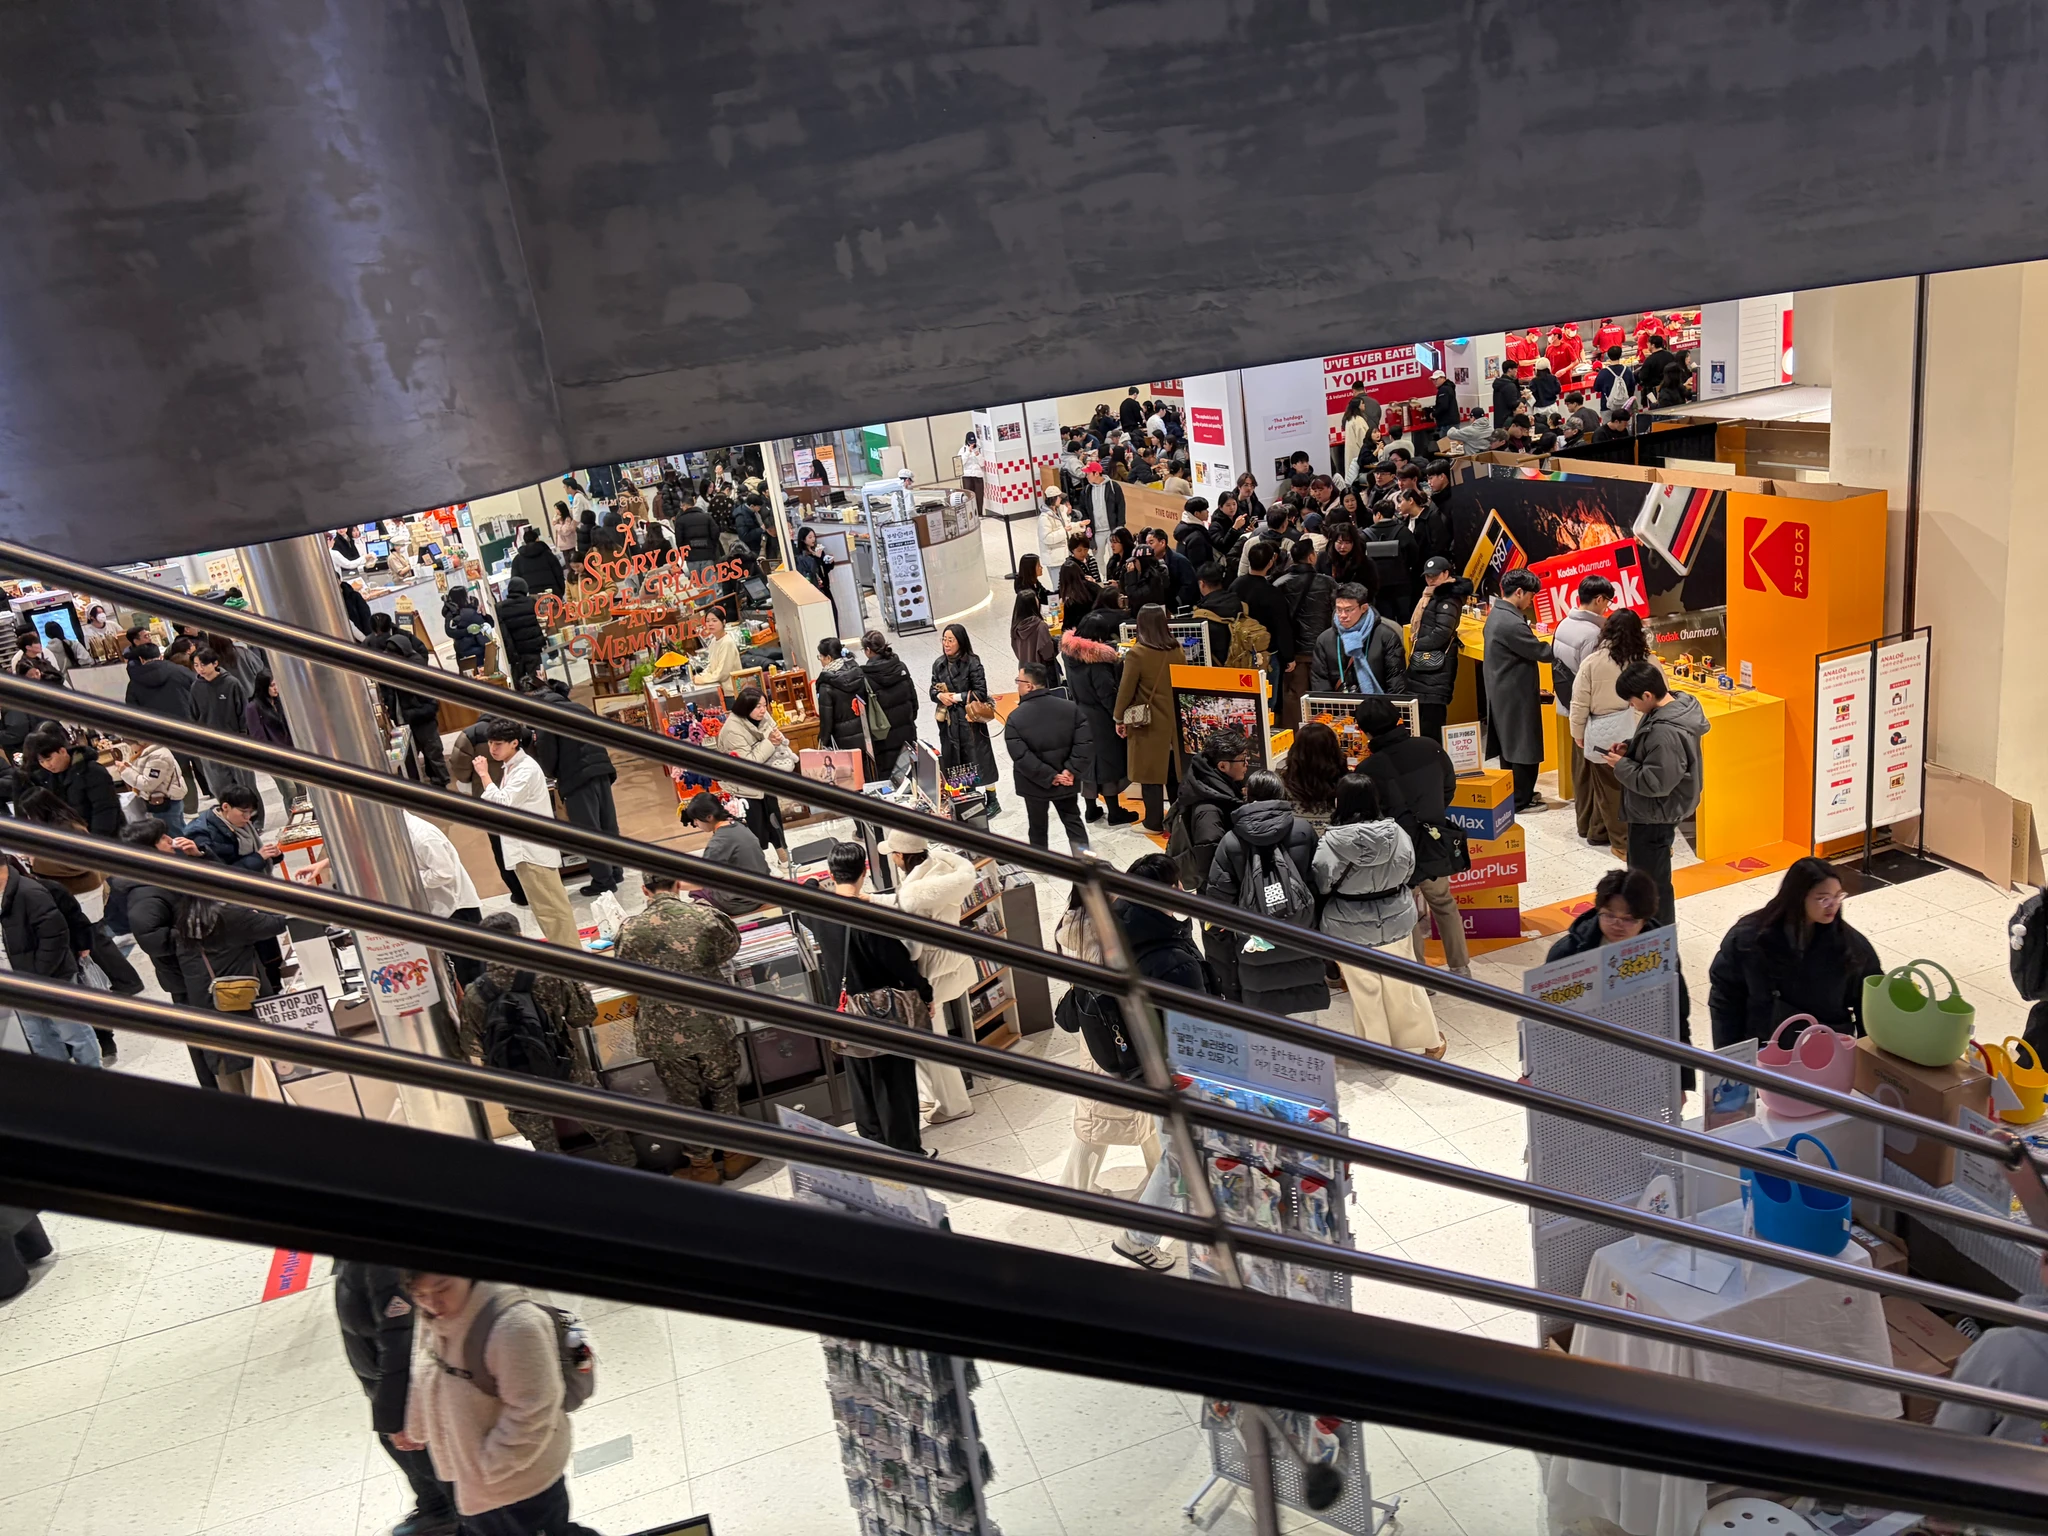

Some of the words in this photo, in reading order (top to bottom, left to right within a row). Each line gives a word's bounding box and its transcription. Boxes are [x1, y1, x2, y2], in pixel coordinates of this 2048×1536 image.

[1324, 358, 1350, 371] U'VE
[1353, 352, 1382, 366] EVER
[1332, 369, 1377, 388] YOUR
[1382, 361, 1419, 379] LIFE!
[619, 495, 628, 507] &
[1155, 507, 1166, 518] FIVE
[1166, 510, 1179, 520] GUYS
[666, 545, 692, 572] OF
[1489, 538, 1507, 572] 1987
[1794, 528, 1804, 593] KODAK
[1557, 566, 1578, 579] Kodak
[1578, 559, 1611, 575] Charmera
[1550, 570, 1645, 623] Koak
[1655, 631, 1680, 643] Kodak
[1679, 626, 1719, 641] Charmera
[1880, 652, 1904, 663] ANALOG
[1823, 666, 1847, 677] ANALOG
[1472, 794, 1476, 803] 1
[1495, 809, 1512, 828] UltraMax
[1469, 843, 1483, 854] ak
[1505, 840, 1510, 849] 1
[1498, 895, 1502, 904] 1
[366, 944, 391, 952] Muscle
[256, 1003, 277, 1018] THE
[280, 992, 319, 1013] POP-UP
[282, 1009, 298, 1022] FEB
[300, 1004, 324, 1018] 2026
[1195, 1050, 1206, 1059] 수
[1255, 1060, 1271, 1073] 여기
